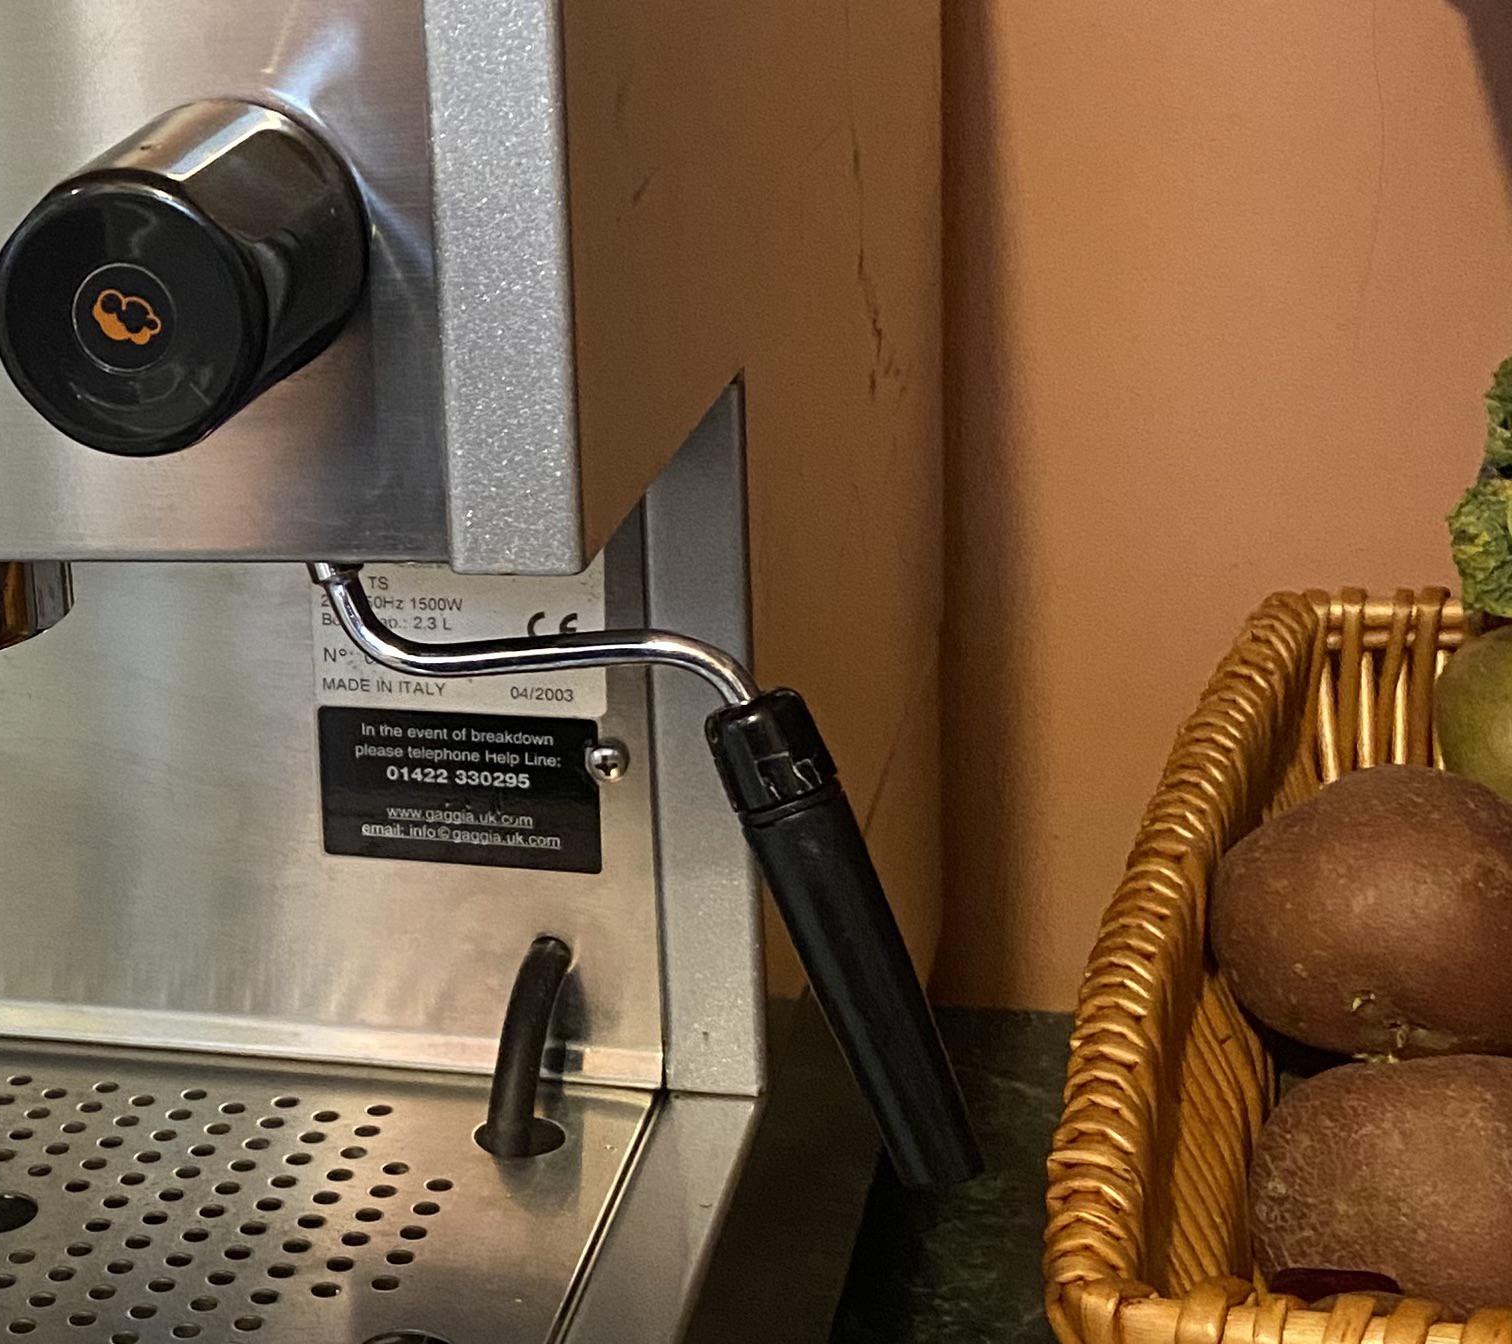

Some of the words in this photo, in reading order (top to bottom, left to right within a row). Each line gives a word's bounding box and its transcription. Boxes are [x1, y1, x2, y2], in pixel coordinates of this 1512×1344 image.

[411, 597, 463, 611] 1500W
[323, 677, 371, 693] MADE
[376, 679, 392, 694] IN
[399, 680, 447, 696] ITALY
[510, 686, 574, 702] 04/2003
[361, 722, 376, 736] In
[380, 724, 403, 738] the
[407, 727, 448, 740] event
[452, 728, 467, 741] of
[471, 729, 554, 746] breakdown
[354, 743, 403, 759] please
[407, 746, 480, 763] telephone
[485, 751, 519, 767] Help
[524, 752, 562, 768] Line:
[386, 765, 448, 784] 01422
[454, 770, 531, 788] 330295
[361, 822, 405, 838] email:
